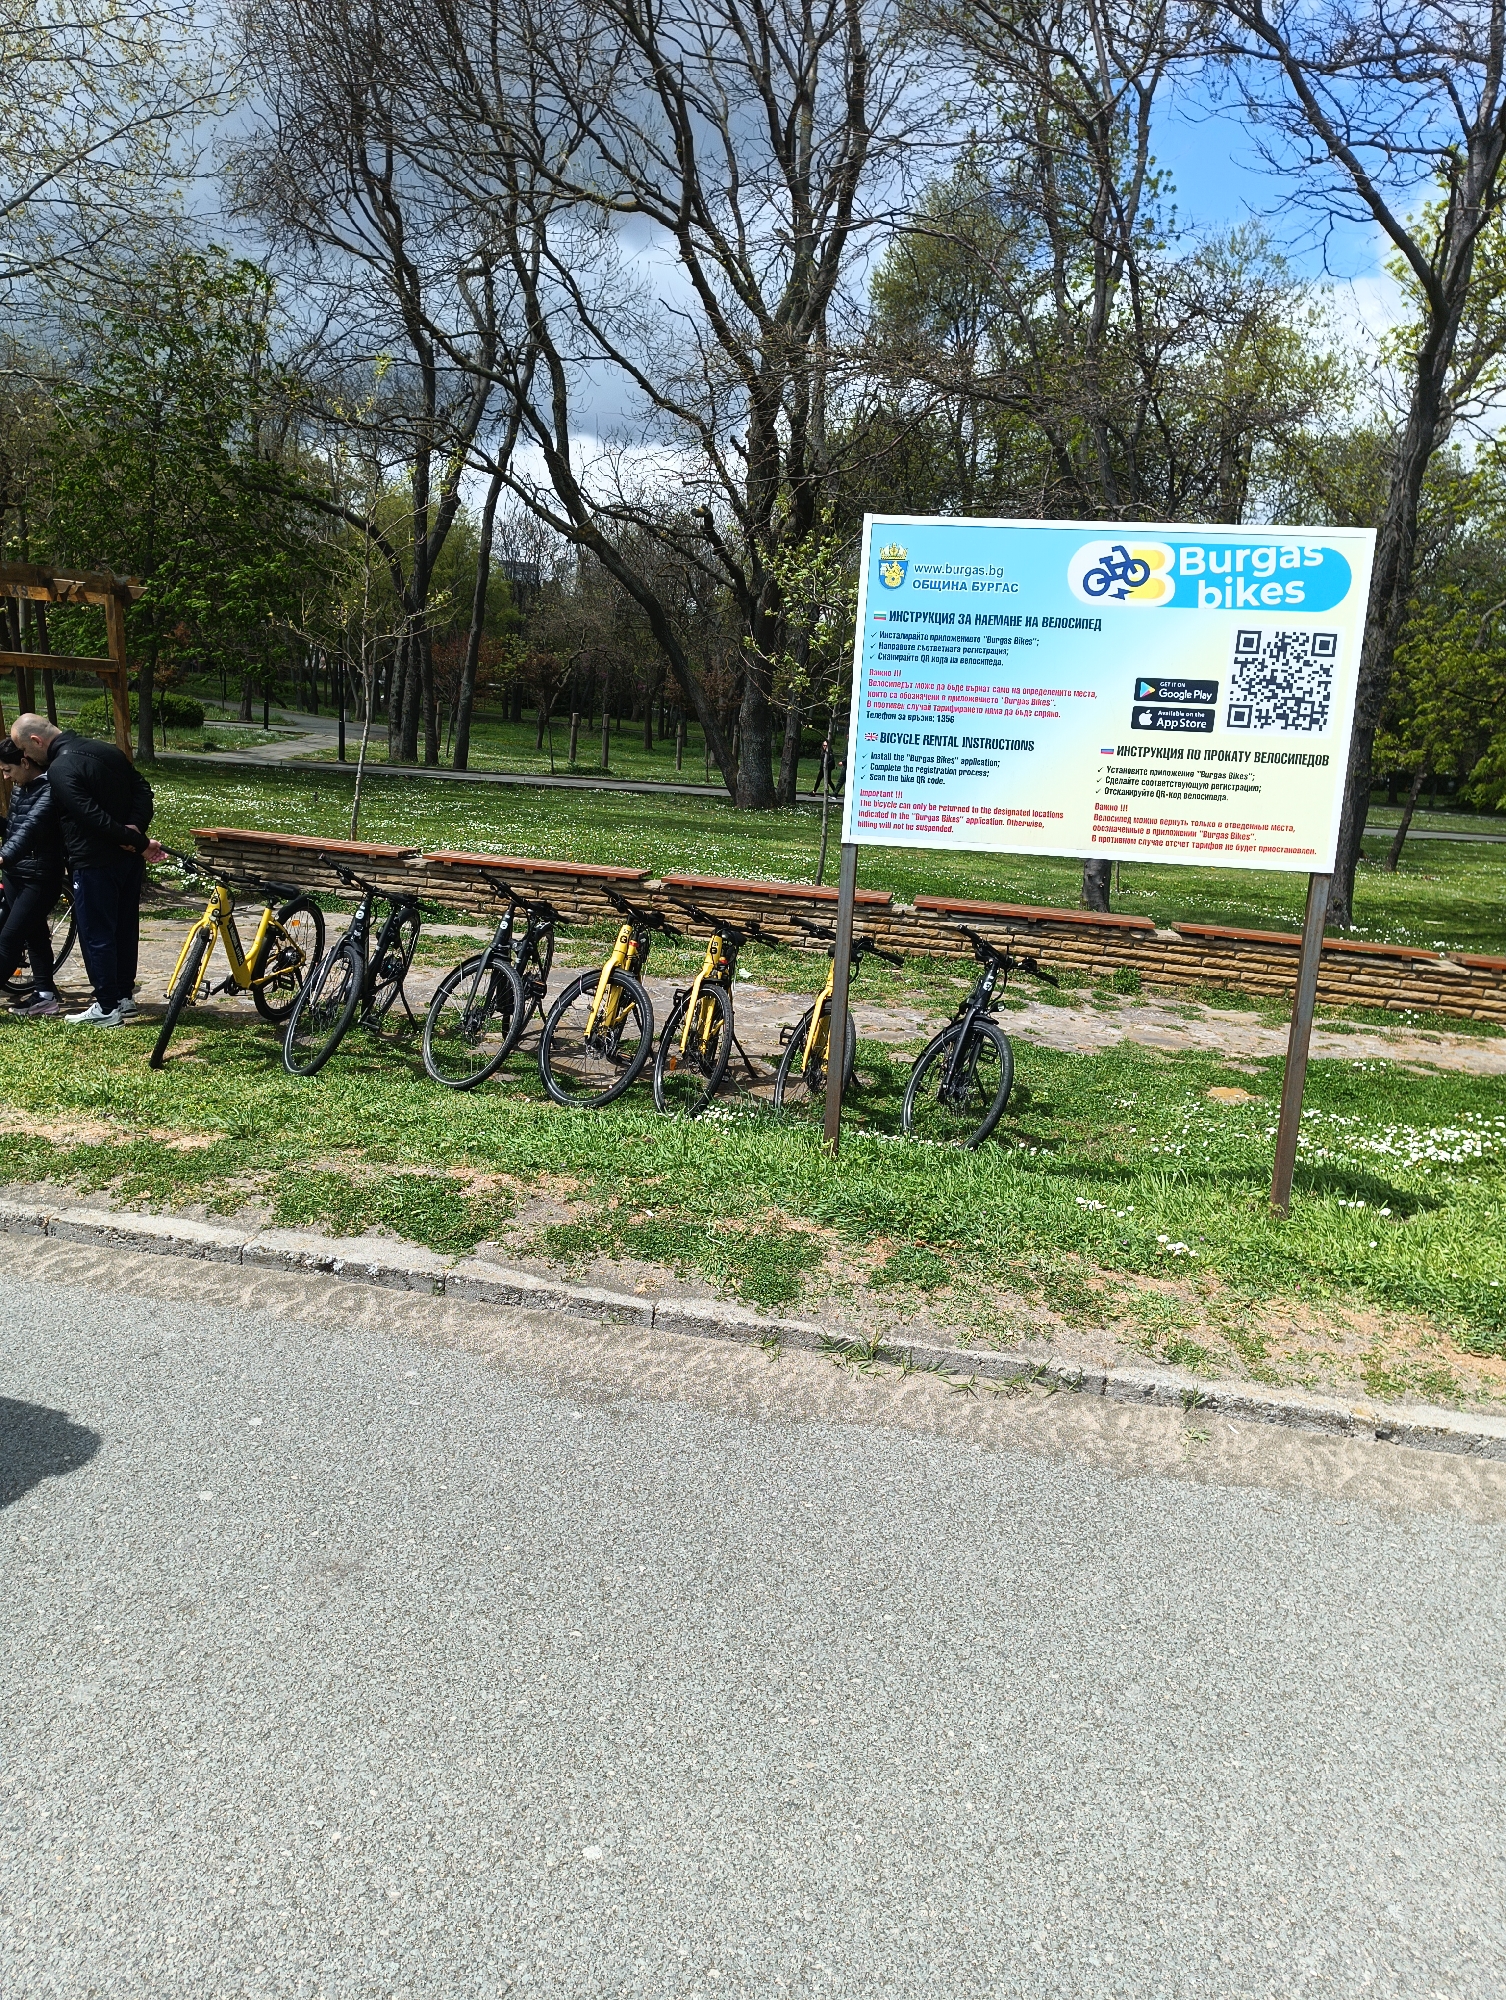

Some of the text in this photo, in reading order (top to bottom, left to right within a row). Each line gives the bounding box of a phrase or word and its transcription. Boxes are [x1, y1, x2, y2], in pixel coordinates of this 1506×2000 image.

[1180, 545, 1324, 578] Burgas
[914, 564, 1004, 578] www.burgas.bg
[912, 579, 1019, 593] ОБЩИНА БУРГАС
[1197, 576, 1305, 609] bikes
[889, 610, 1102, 632] ИНСТРУКЦИЯ ЗА НАЕМАНЕ НА ВЕЛОСИПЕД
[1159, 688, 1212, 701] Google Play
[937, 715, 954, 723] 1356
[1156, 717, 1207, 729] App Store
[880, 732, 1035, 751] BICYCLE RENTAL INSTRUCTIONS
[870, 752, 1000, 768] Install the "Burgas Bikes" application;
[1116, 746, 1329, 767] ИНСТРУКЦИЯ ПО ПРОКАТУ ВЕЛОСИПЕДОВ
[870, 763, 901, 772] Complete
[915, 766, 957, 775] registration
[959, 769, 990, 777] process;
[1106, 766, 1148, 776] Установите
[1150, 769, 1194, 777] приложение
[916, 776, 925, 784] QR
[927, 776, 945, 785] code.
[1106, 776, 1262, 793] Сделайте соответствующую регистрацию;
[860, 789, 893, 798] Important
[1104, 787, 1229, 802] Отсканируйте QR-код велосипеда.
[874, 800, 897, 809] bicycle
[912, 803, 927, 811] only
[938, 805, 970, 813] returned
[994, 807, 1030, 817] designated
[1032, 810, 1064, 819] locations
[1094, 803, 1118, 811] Важно
[858, 820, 878, 829] billing
[916, 824, 954, 833] suspended.
[941, 814, 964, 823] Bikes"
[966, 817, 1004, 826] application.
[1006, 818, 1044, 829] Otherwise,
[1094, 814, 1132, 824] Велосипед
[1133, 817, 1158, 825] можно
[1160, 818, 1188, 826] вернуть
[1191, 820, 1216, 828] только
[1224, 822, 1269, 831] отведенные
[1271, 824, 1296, 833] места,
[1098, 836, 1136, 845] противном
[1138, 838, 1163, 846] случае
[1192, 842, 1223, 851] тарифов
[1236, 844, 1257, 852] будет
[1259, 846, 1317, 855] приостановлен.
